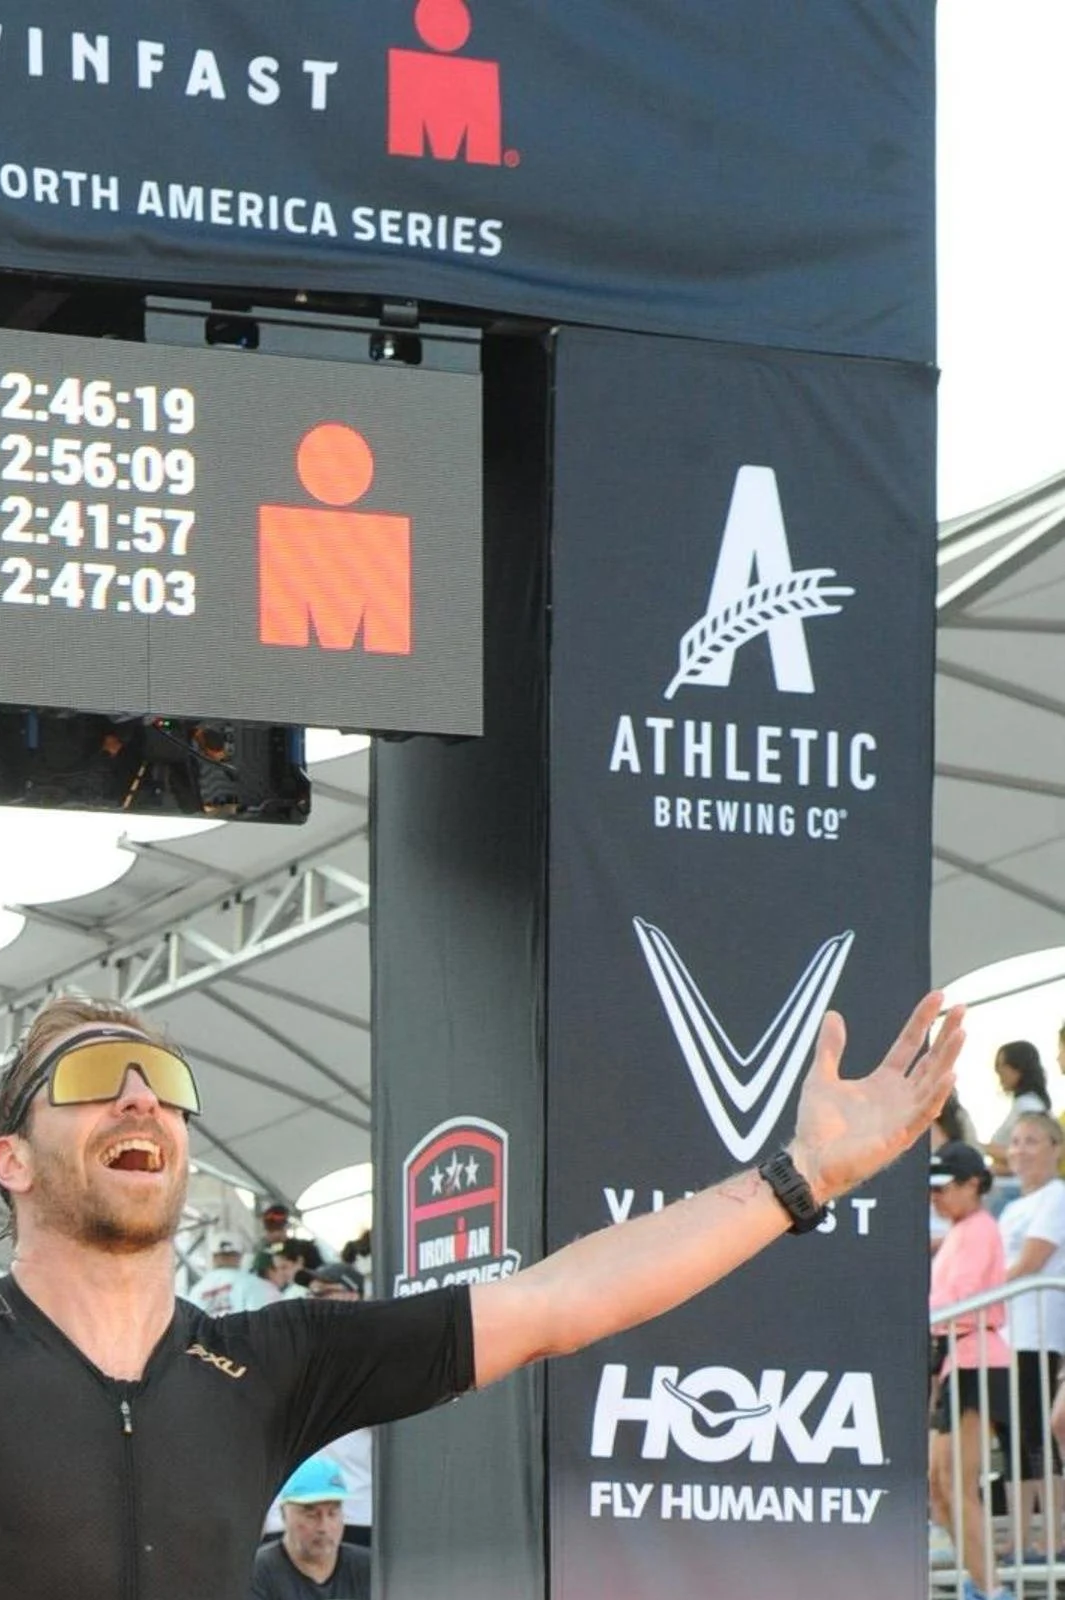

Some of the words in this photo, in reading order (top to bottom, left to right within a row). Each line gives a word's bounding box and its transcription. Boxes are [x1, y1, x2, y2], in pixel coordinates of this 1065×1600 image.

[138, 180, 337, 237] AMERICA
[352, 206, 503, 256] SERIES
[609, 715, 877, 791] ATHLETIC
[654, 795, 795, 836] BREWING
[591, 1364, 885, 1465] HOKA
[590, 1481, 654, 1519] FLY
[661, 1483, 814, 1522] HUMAN
[821, 1486, 884, 1524] FLY
